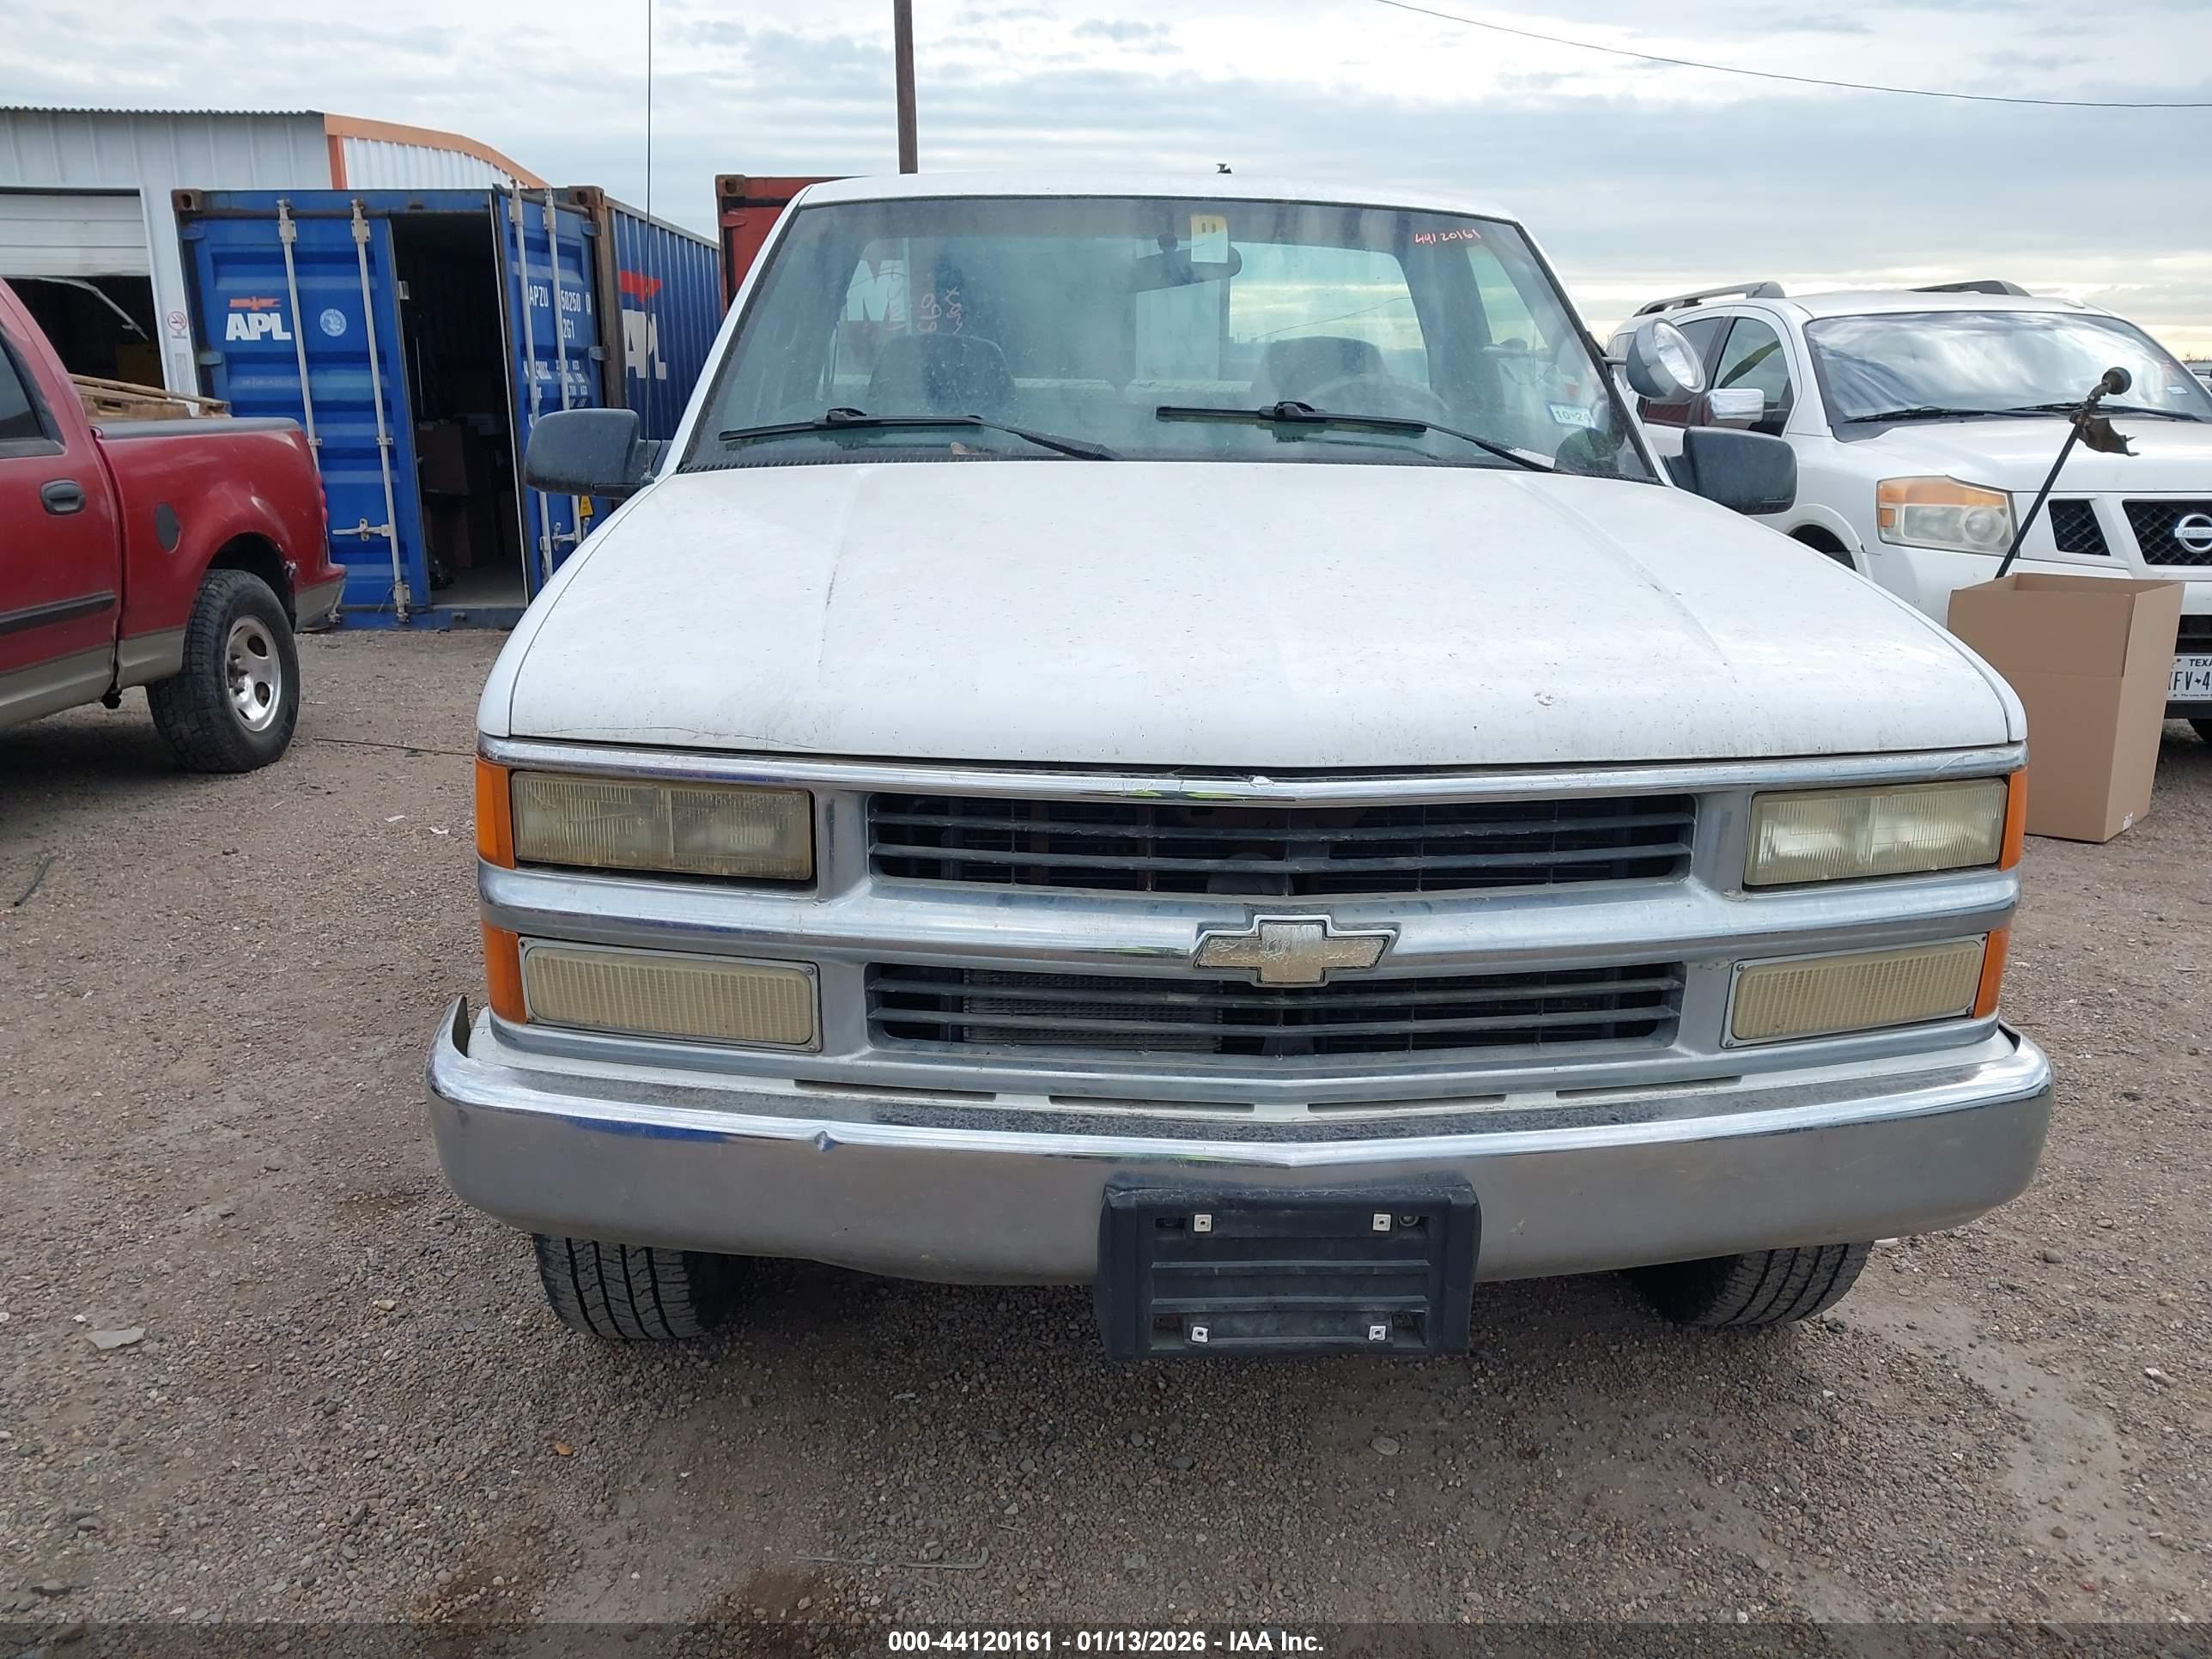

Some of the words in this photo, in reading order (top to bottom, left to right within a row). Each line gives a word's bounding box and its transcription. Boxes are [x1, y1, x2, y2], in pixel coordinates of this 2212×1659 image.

[529, 284, 549, 307] APZU
[225, 313, 292, 340] APL
[621, 308, 667, 380] APL
